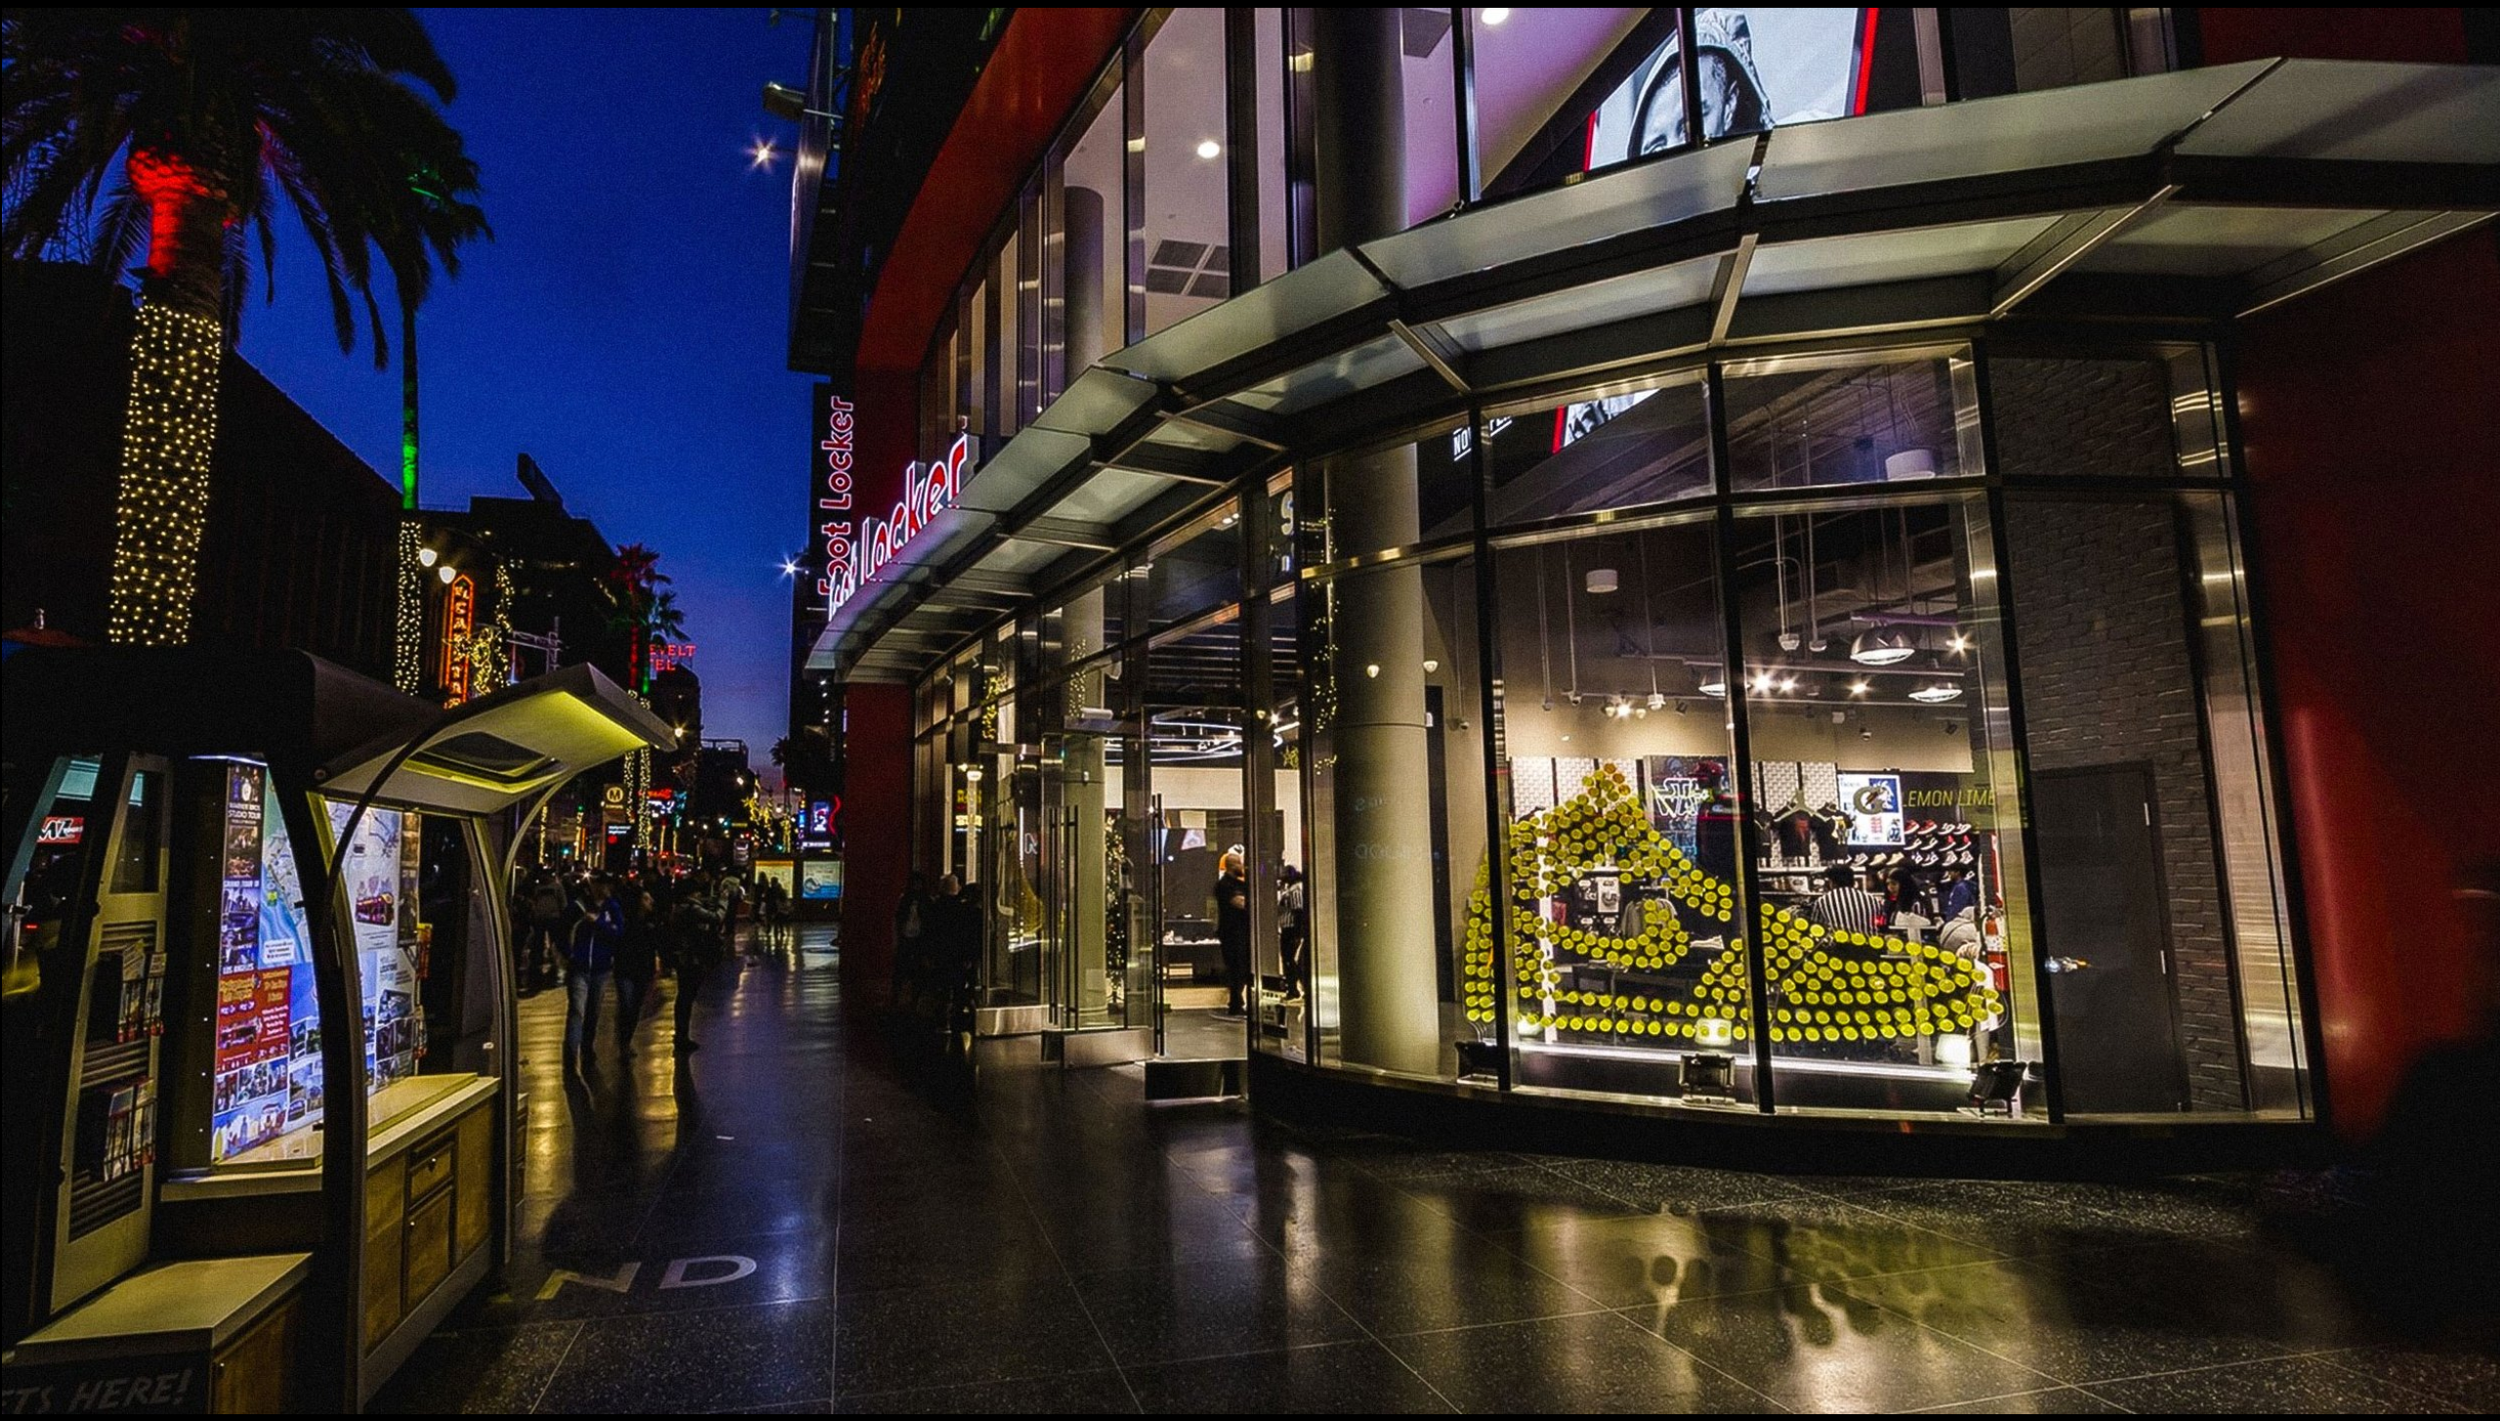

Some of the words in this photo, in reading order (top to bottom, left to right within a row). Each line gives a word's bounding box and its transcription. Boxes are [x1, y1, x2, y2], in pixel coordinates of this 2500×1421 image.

[819, 395, 854, 511] Locker
[860, 433, 968, 585] Locker
[65, 1368, 193, 1414] HERE!
